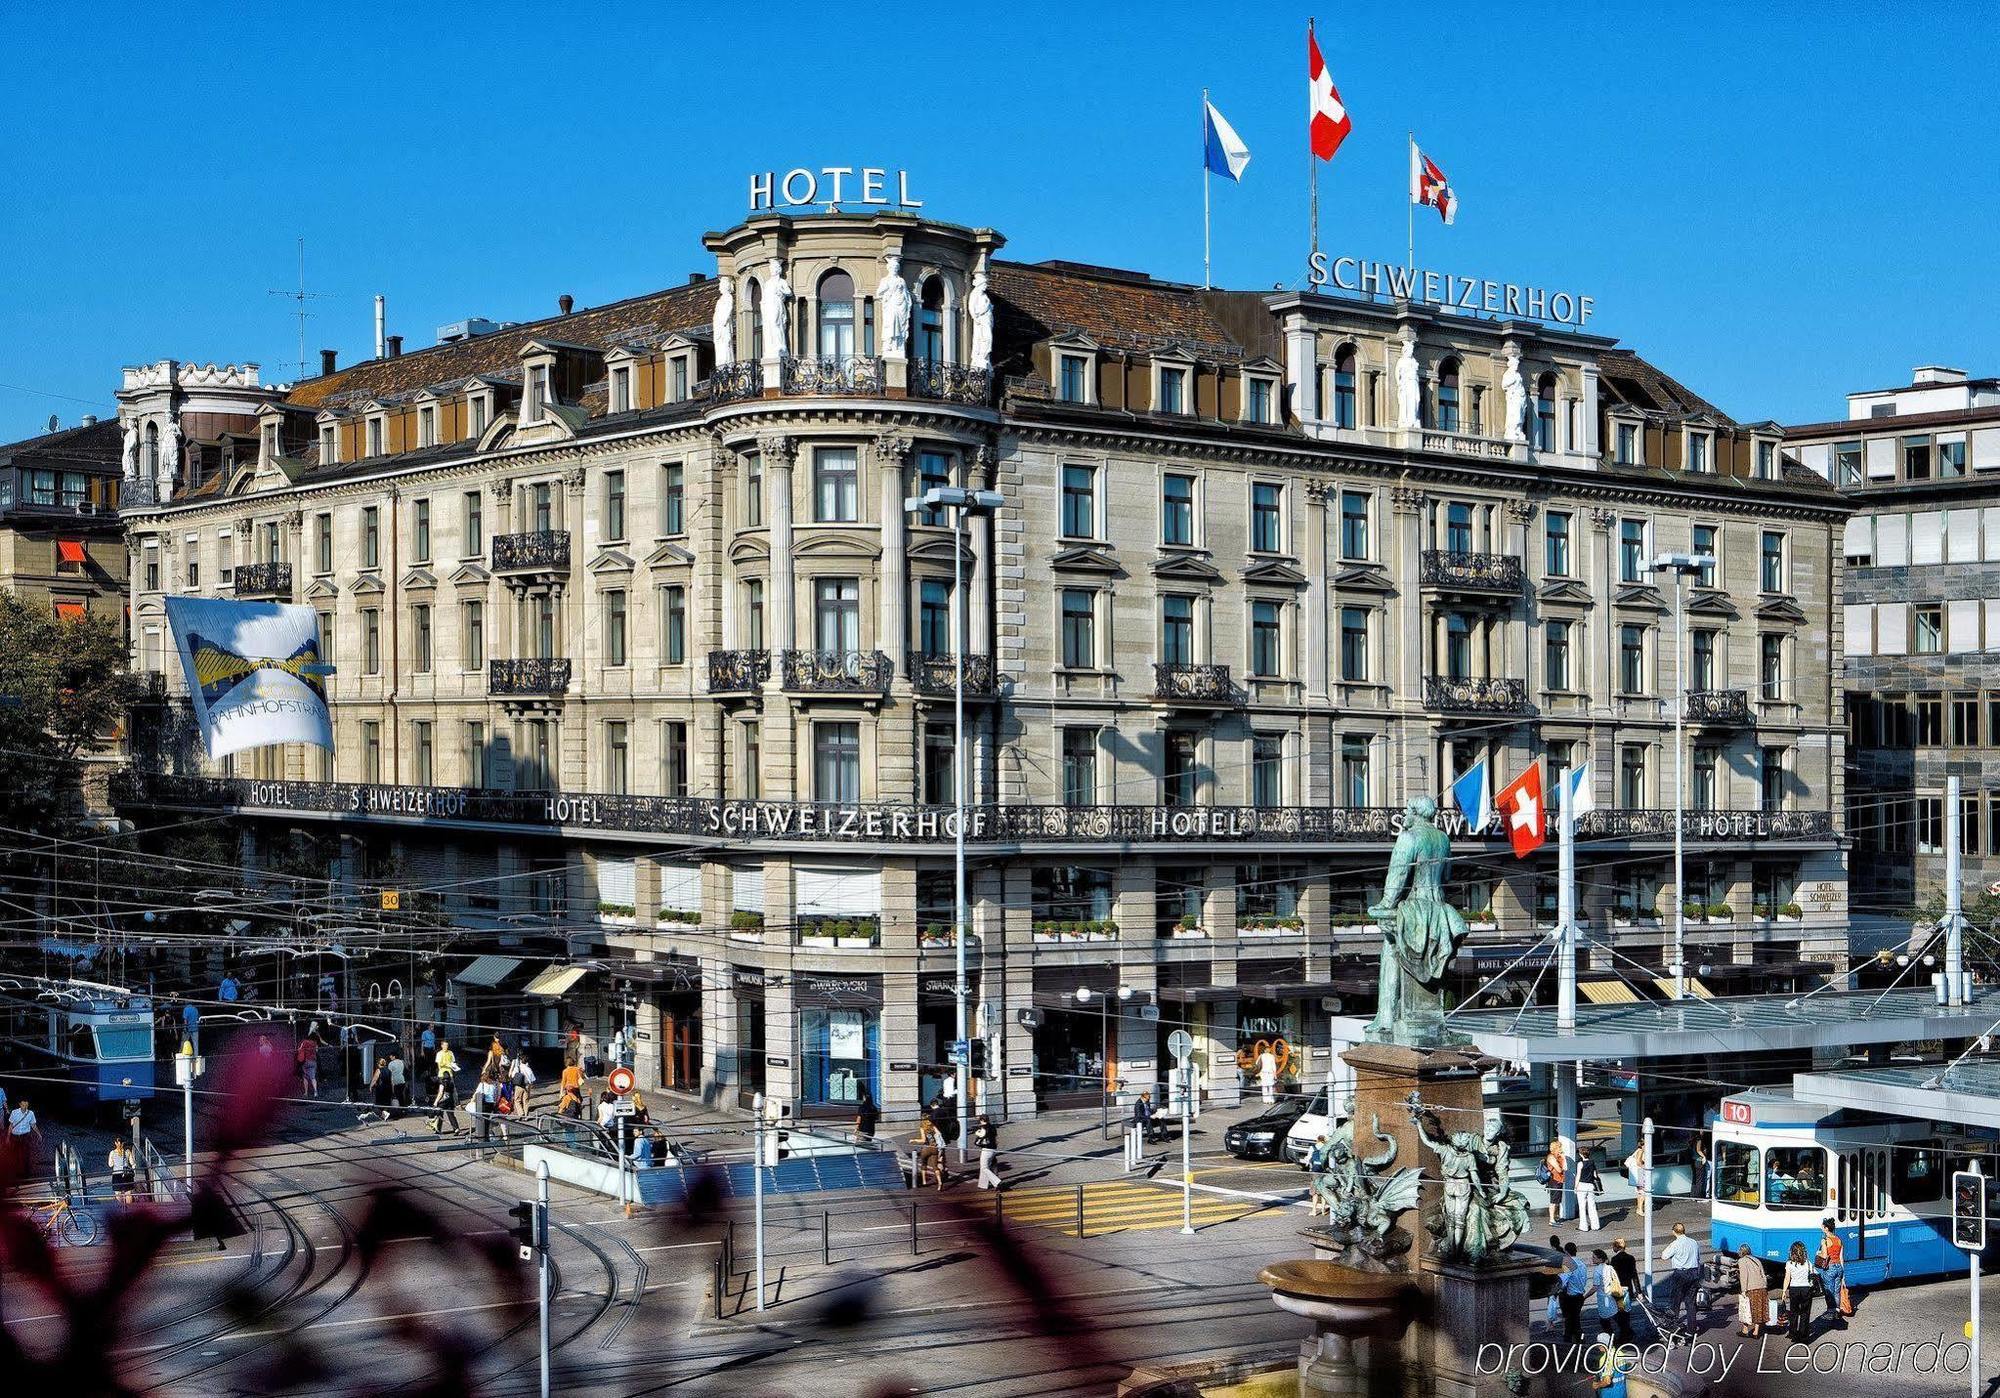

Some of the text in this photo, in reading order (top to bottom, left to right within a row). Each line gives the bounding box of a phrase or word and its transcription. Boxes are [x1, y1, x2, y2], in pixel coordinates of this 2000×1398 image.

[750, 167, 923, 210] HOTEL
[1308, 251, 1595, 326] SCHWEIZERHOF
[251, 783, 291, 805] HOTEL
[351, 788, 467, 815] SCHWEIZERHOF
[544, 797, 602, 823] HOTEL
[708, 805, 986, 838] SCHWEIZERHOF
[1150, 811, 1242, 836] HOTEL
[1700, 815, 1768, 837] HOTEL
[1809, 892, 1842, 902] SCHWEIZER
[1816, 882, 1836, 891] HOTEL
[383, 895, 398, 905] 30
[1477, 959, 1502, 969] HOTEL
[1729, 1104, 1748, 1121] 10
